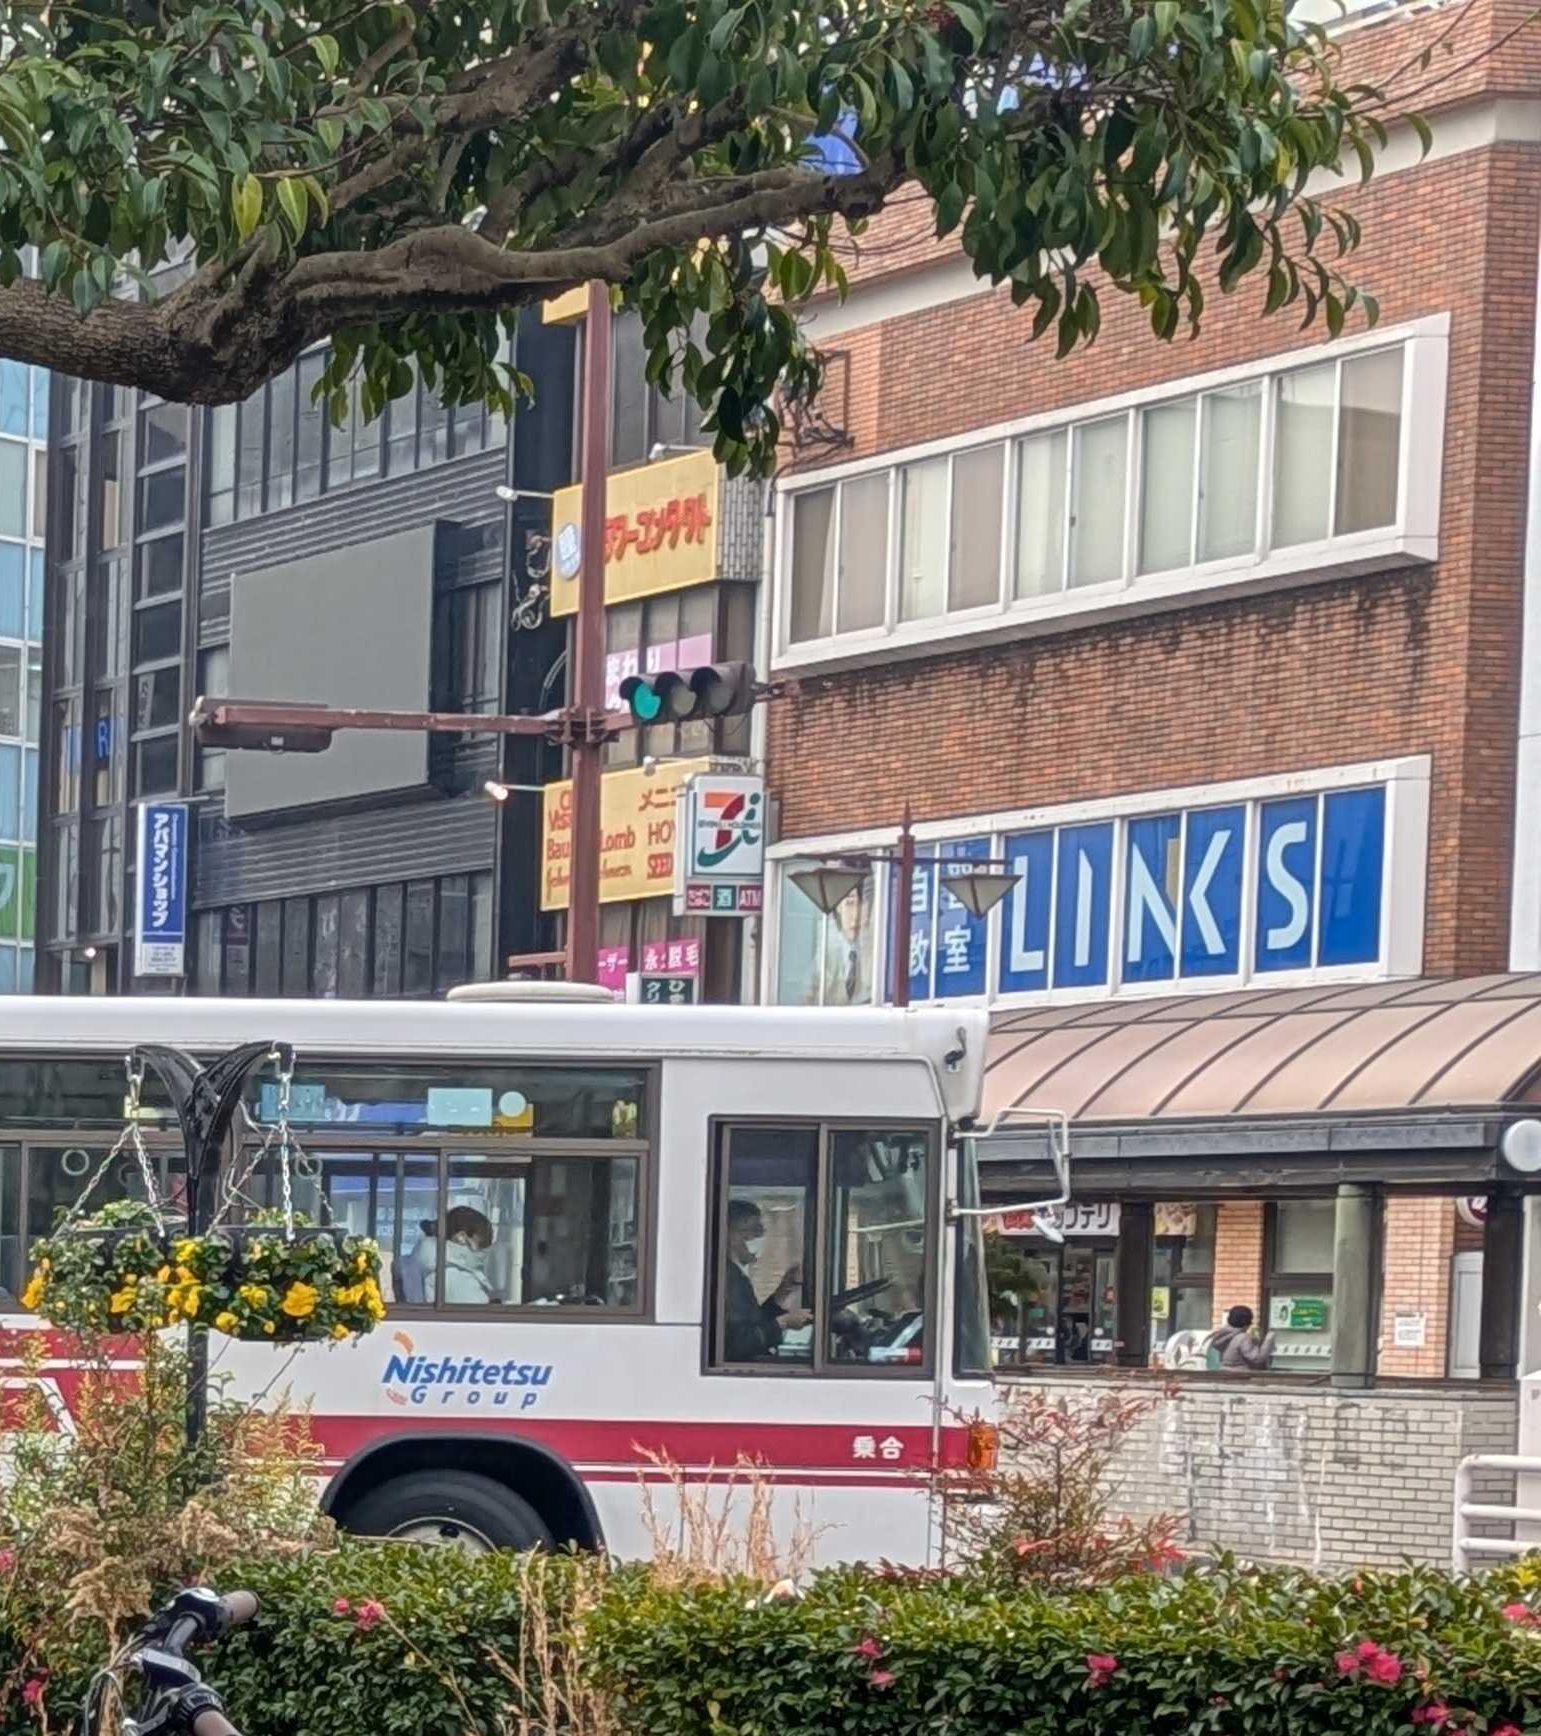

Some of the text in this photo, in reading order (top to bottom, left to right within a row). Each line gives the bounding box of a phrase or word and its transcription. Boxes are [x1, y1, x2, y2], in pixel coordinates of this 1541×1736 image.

[1008, 821, 1308, 974] LINKS
[381, 1354, 554, 1386] Nishitetsu
[410, 1385, 538, 1411] Group
[852, 1435, 905, 1460] 乗合
